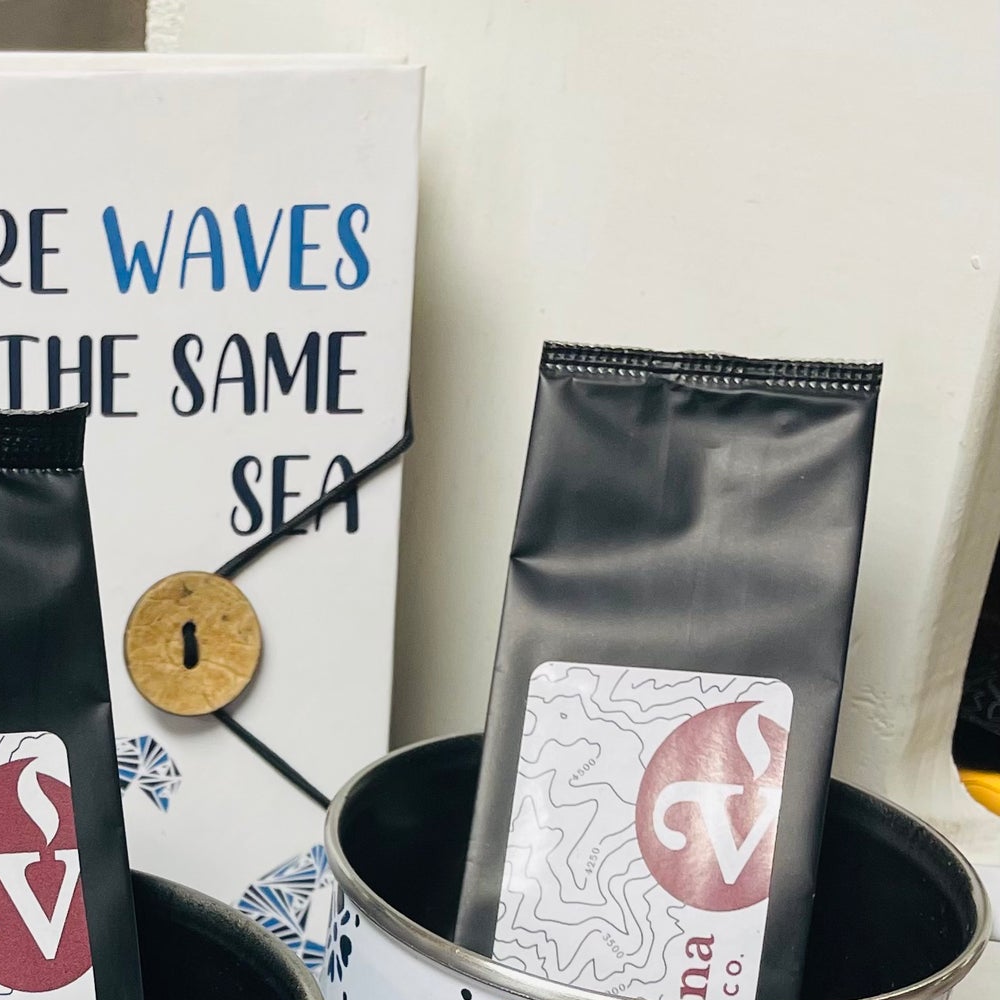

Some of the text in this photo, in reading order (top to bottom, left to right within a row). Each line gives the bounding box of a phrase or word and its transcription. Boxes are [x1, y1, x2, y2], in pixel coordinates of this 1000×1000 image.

[102, 203, 370, 294] WAVES
[171, 330, 367, 417] SAME
[230, 453, 360, 536] SEA
[571, 758, 597, 781] 4500
[584, 847, 600, 875] 4250
[602, 933, 624, 959] 3500
[723, 954, 745, 996] CO.
